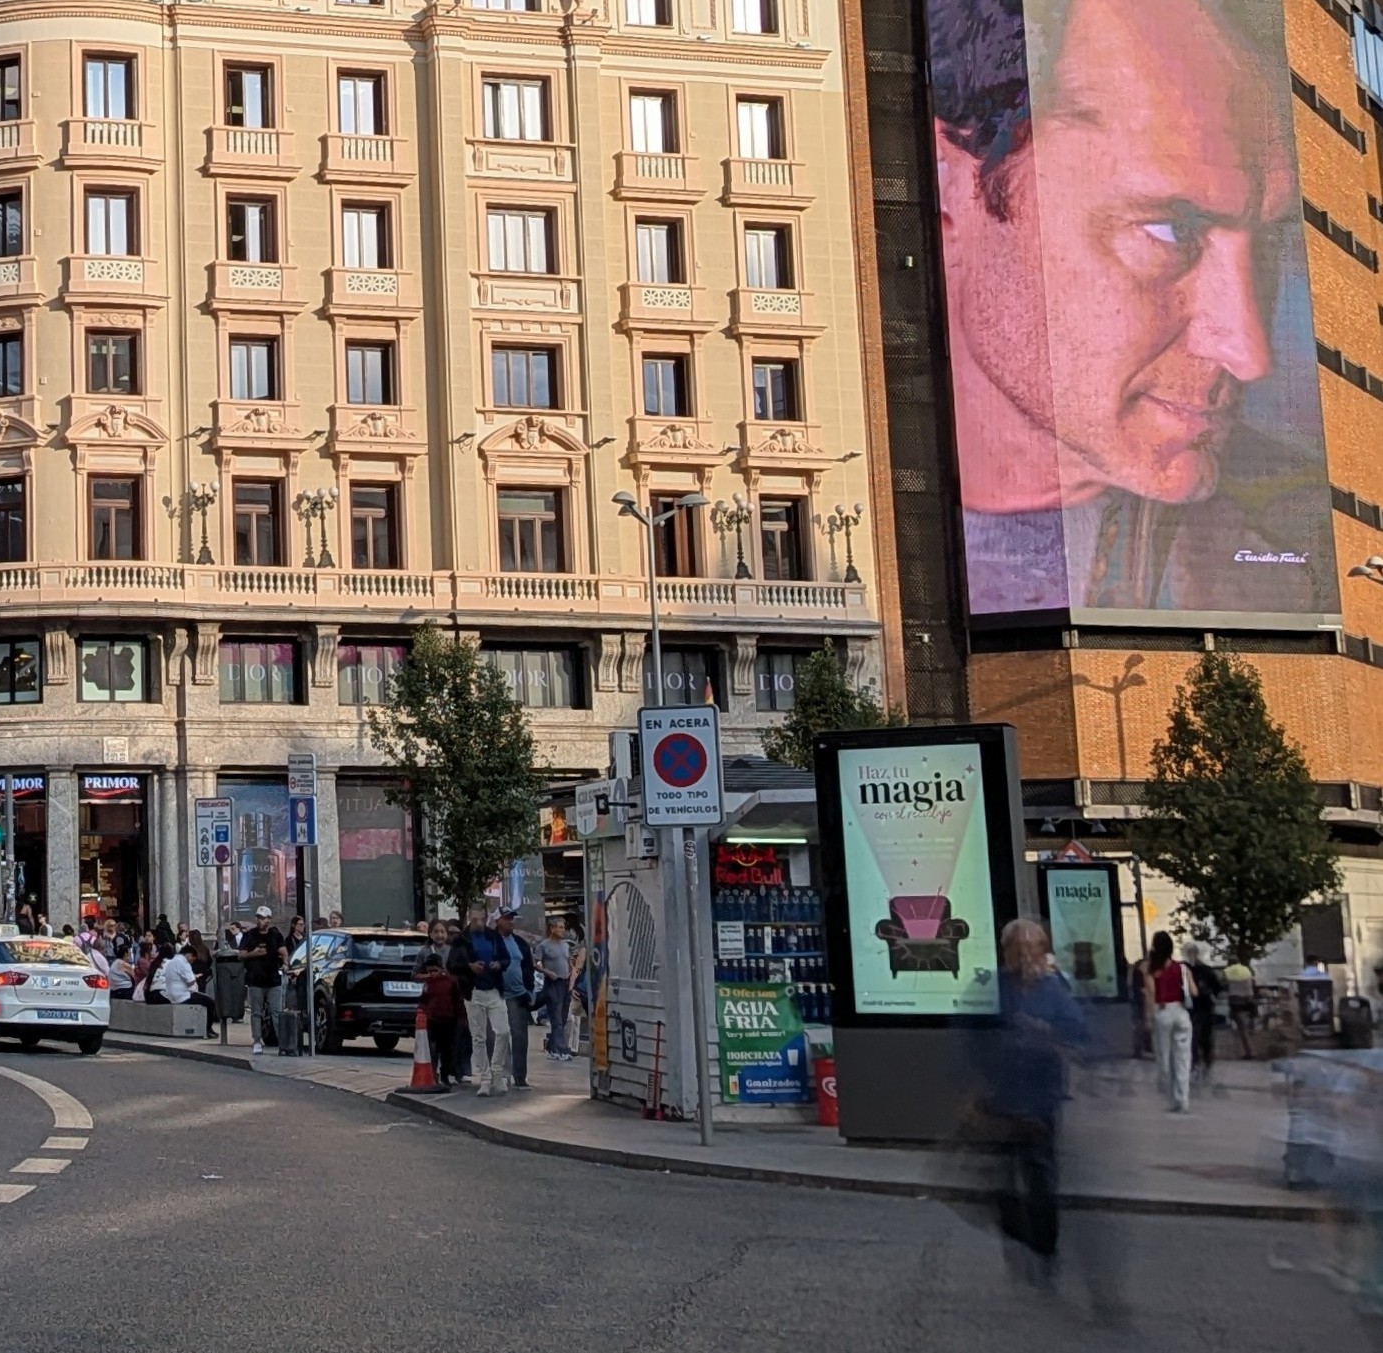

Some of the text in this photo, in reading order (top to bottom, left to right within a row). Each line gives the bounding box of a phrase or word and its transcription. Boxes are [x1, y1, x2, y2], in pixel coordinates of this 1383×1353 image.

[228, 663, 282, 682] DIOR
[645, 717, 710, 730] EN ACERA
[893, 766, 910, 779] tu
[84, 776, 140, 789] PRIMOR
[656, 790, 708, 800] TODO TIPO
[859, 771, 966, 812] magia
[648, 804, 718, 815] DE VEHÍCULOS
[716, 866, 783, 885] Red Bull
[1055, 882, 1102, 902] magia
[723, 1000, 780, 1016] AGUA
[726, 1051, 782, 1060] HORCHATA
